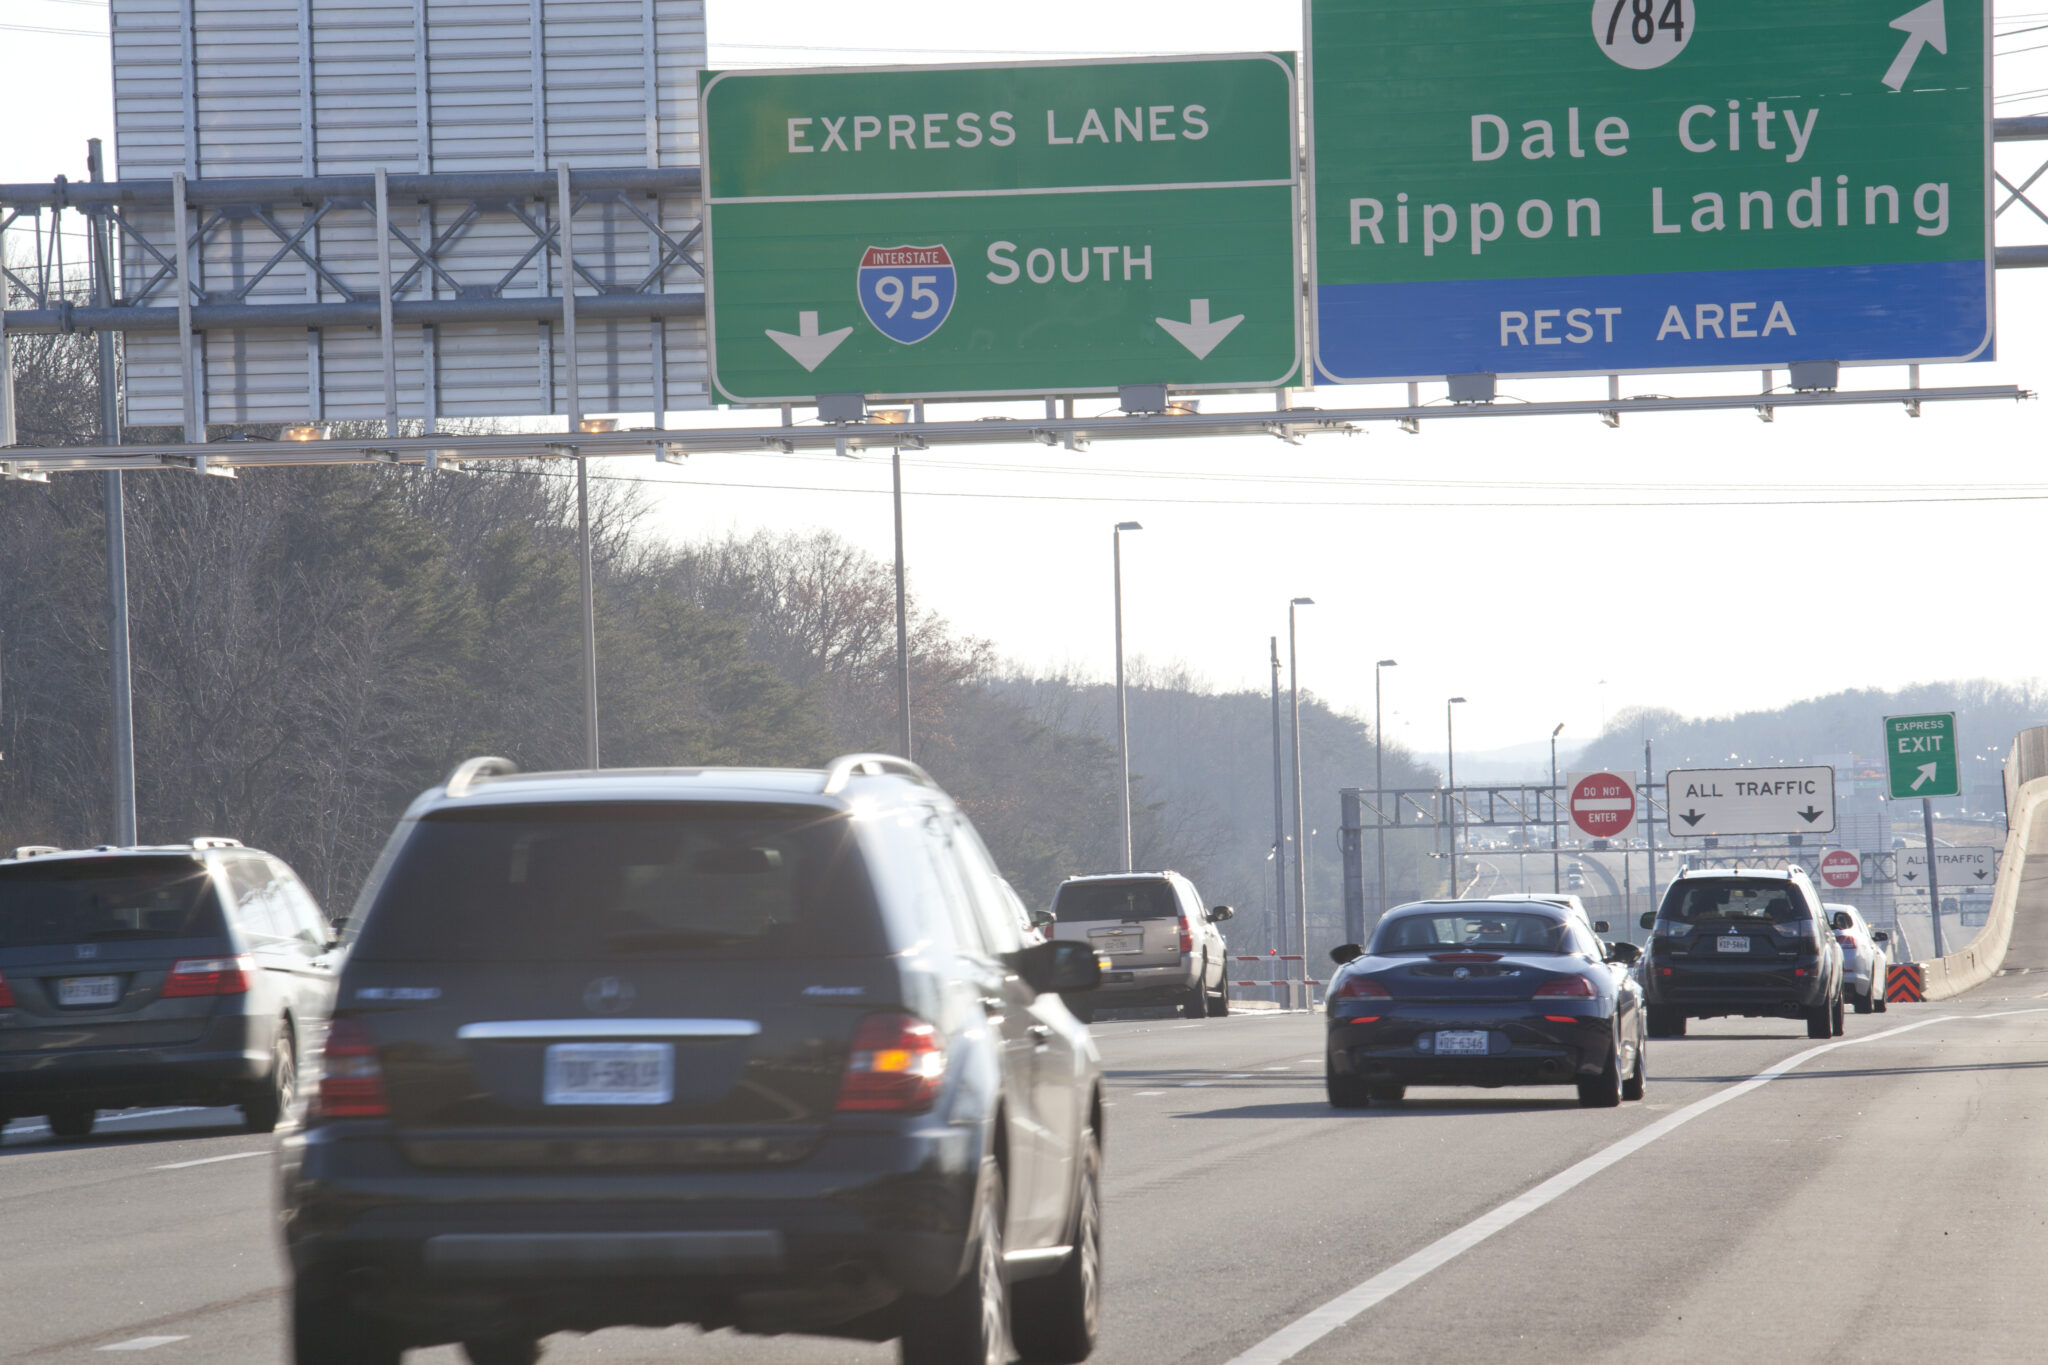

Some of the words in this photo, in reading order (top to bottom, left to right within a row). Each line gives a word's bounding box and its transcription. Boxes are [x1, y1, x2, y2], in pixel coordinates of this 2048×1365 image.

[1606, 0, 1684, 45] 784
[788, 111, 1015, 154] EXPRESS
[1048, 105, 1209, 145] LANES
[1472, 107, 1630, 162] Dale
[1679, 100, 1819, 163] City
[1350, 192, 1602, 257] Rippon
[1653, 175, 1949, 237] Landing
[872, 251, 940, 265] INTERSTATE
[986, 241, 1152, 285] SOUTH
[875, 275, 940, 320] 95
[1500, 308, 1622, 347] REST
[1656, 301, 1797, 341] AREA
[1895, 720, 1944, 731] EXPRESS
[1898, 735, 1943, 753] EXIT
[1583, 786, 1596, 797] DO
[1602, 786, 1621, 796] NOT
[1686, 783, 1723, 798] ALL
[1736, 781, 1816, 796] TRAFFIC
[1588, 812, 1617, 823] ENTER
[1936, 854, 1985, 864] TRAFFIC
